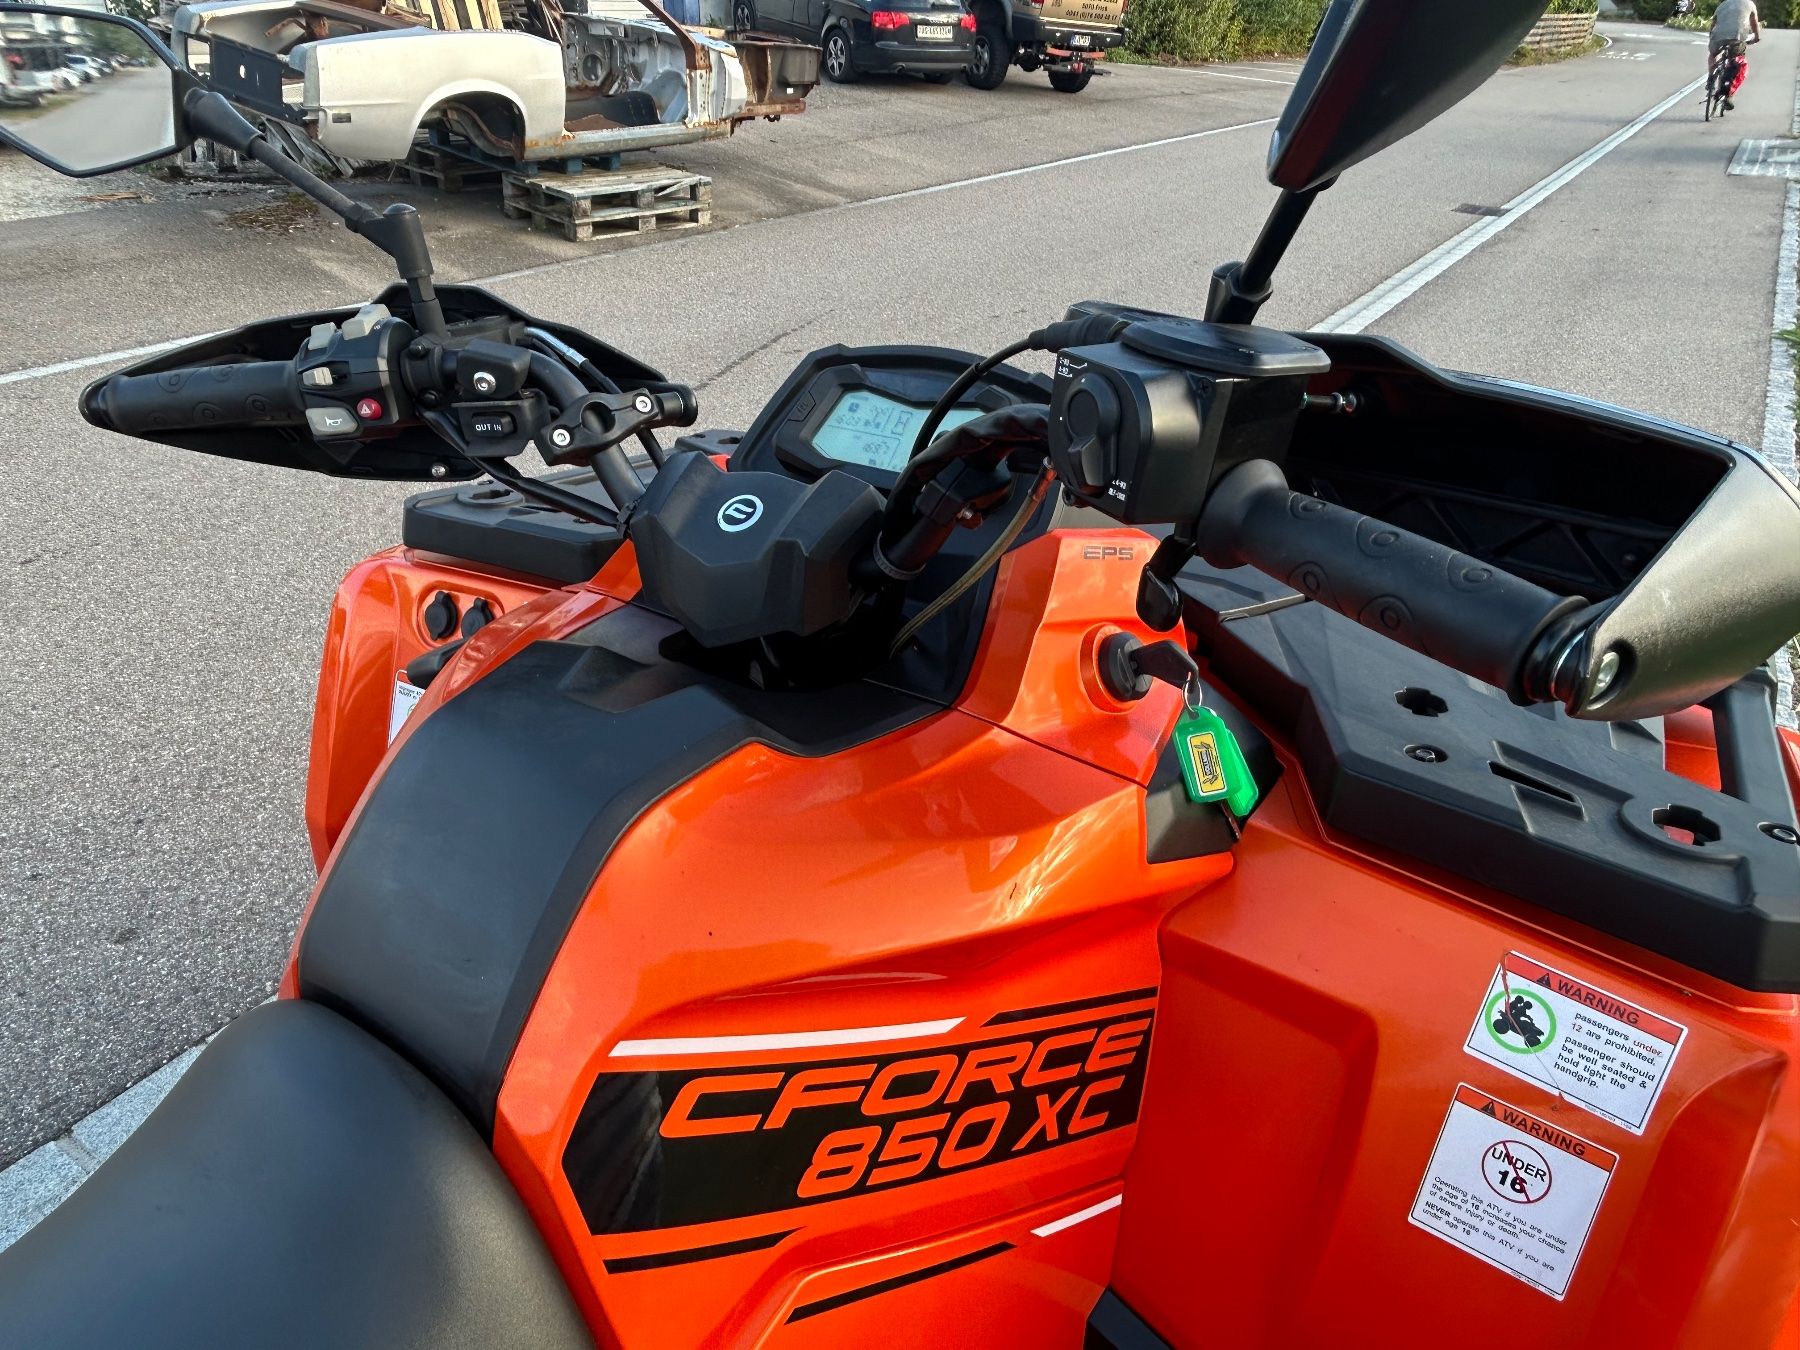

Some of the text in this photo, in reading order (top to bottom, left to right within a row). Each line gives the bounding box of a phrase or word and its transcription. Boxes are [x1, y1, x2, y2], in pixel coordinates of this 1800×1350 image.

[475, 423, 502, 431] OUT IN
[1083, 545, 1134, 561] EPS
[1558, 978, 1639, 1025] WARNING
[1571, 1022, 1656, 1067] 12 are prohibited.
[1574, 1012, 1663, 1058] passengers under
[658, 1017, 1152, 1139] CFORCE
[1553, 1061, 1599, 1089] handgrip.
[1557, 1052, 1626, 1090] hold tight the
[1561, 1043, 1647, 1089] be well seated &
[1564, 1036, 1656, 1082] passenger should
[796, 1074, 1126, 1199] 850 XC
[1502, 1108, 1586, 1157] WARNING
[1491, 1146, 1548, 1183] UNDER
[1498, 1169, 1528, 1195] 16
[1433, 1176, 1468, 1198] Operating
[1486, 1202, 1503, 1214] ATV
[1512, 1215, 1527, 1227] you
[1465, 1207, 1485, 1222] injury
[1471, 1202, 1480, 1211] 16
[1424, 1200, 1451, 1218] NEVER
[1498, 1238, 1515, 1250] ATV
[1524, 1252, 1539, 1264] you
[1462, 1227, 1471, 1236] 16
